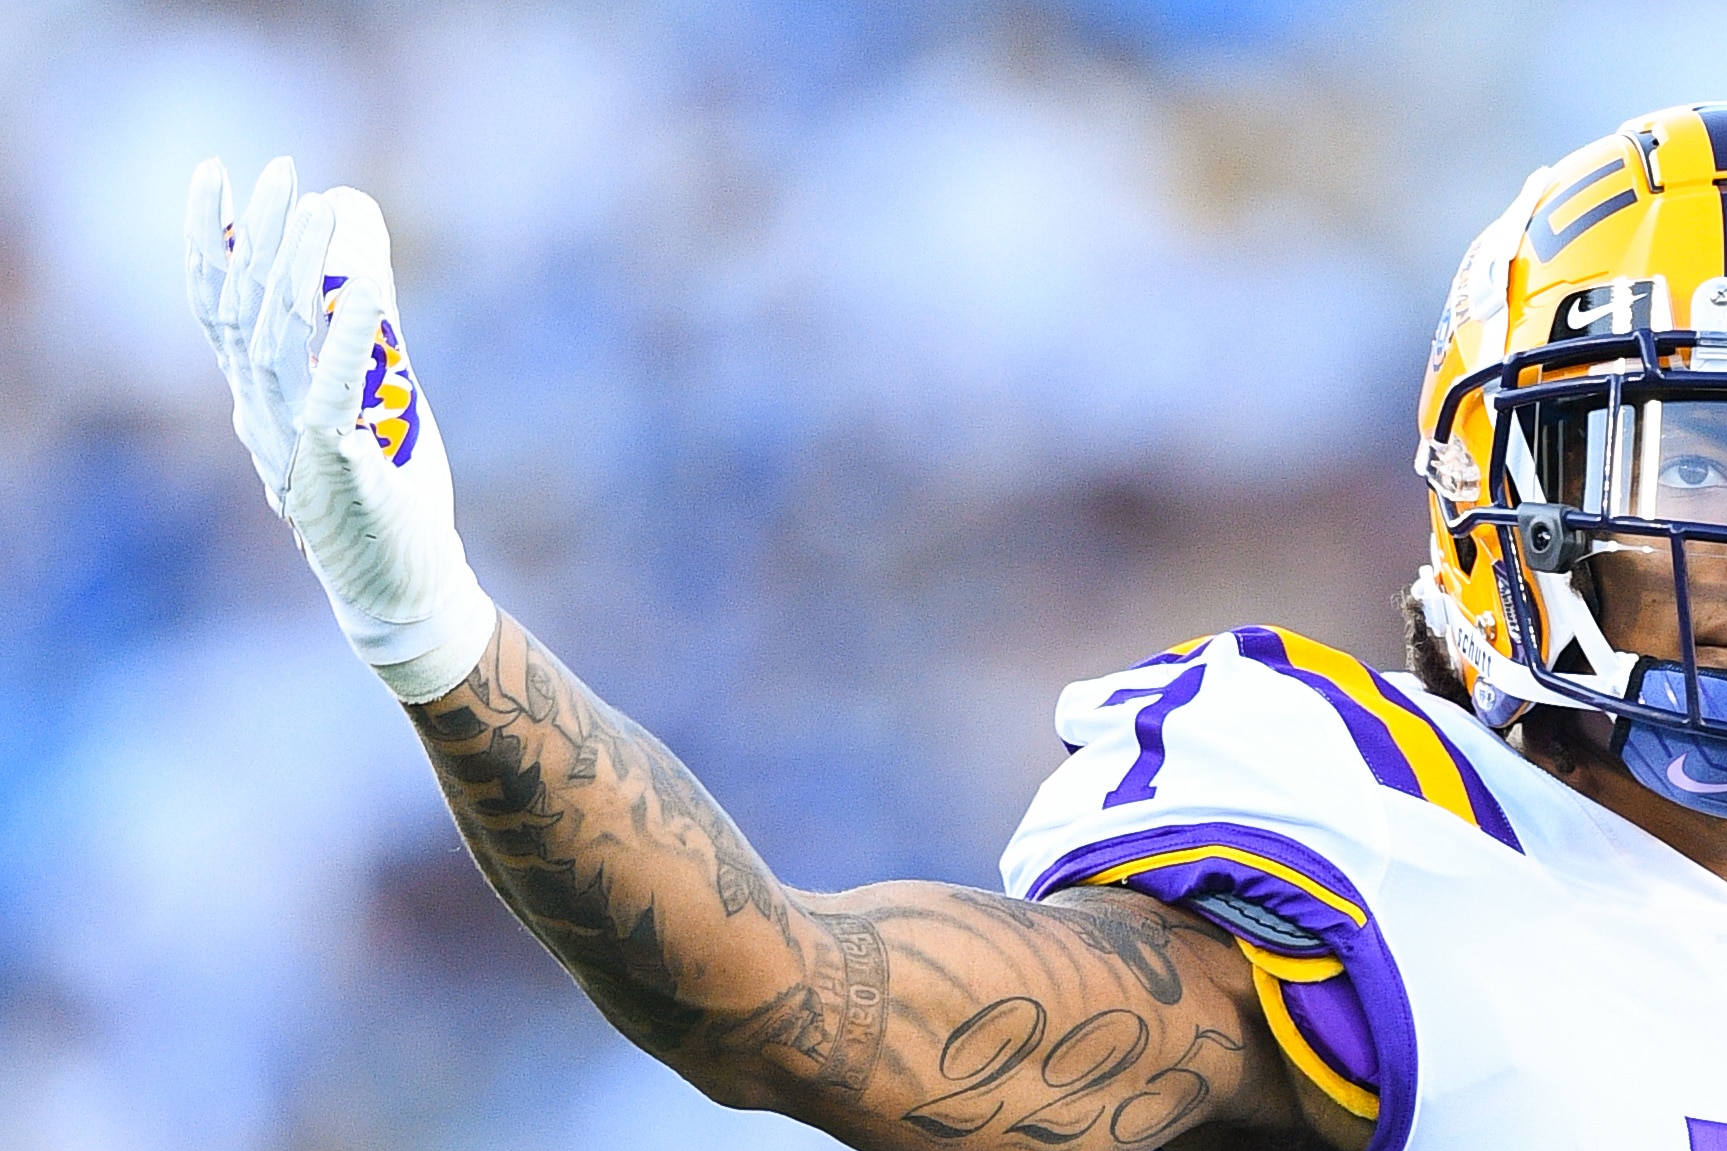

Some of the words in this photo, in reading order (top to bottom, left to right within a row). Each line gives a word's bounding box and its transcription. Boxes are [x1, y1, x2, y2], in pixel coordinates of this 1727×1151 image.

[1457, 627, 1491, 678] schutt
[1095, 663, 1208, 810] 7
[903, 997, 1245, 1144] 225
